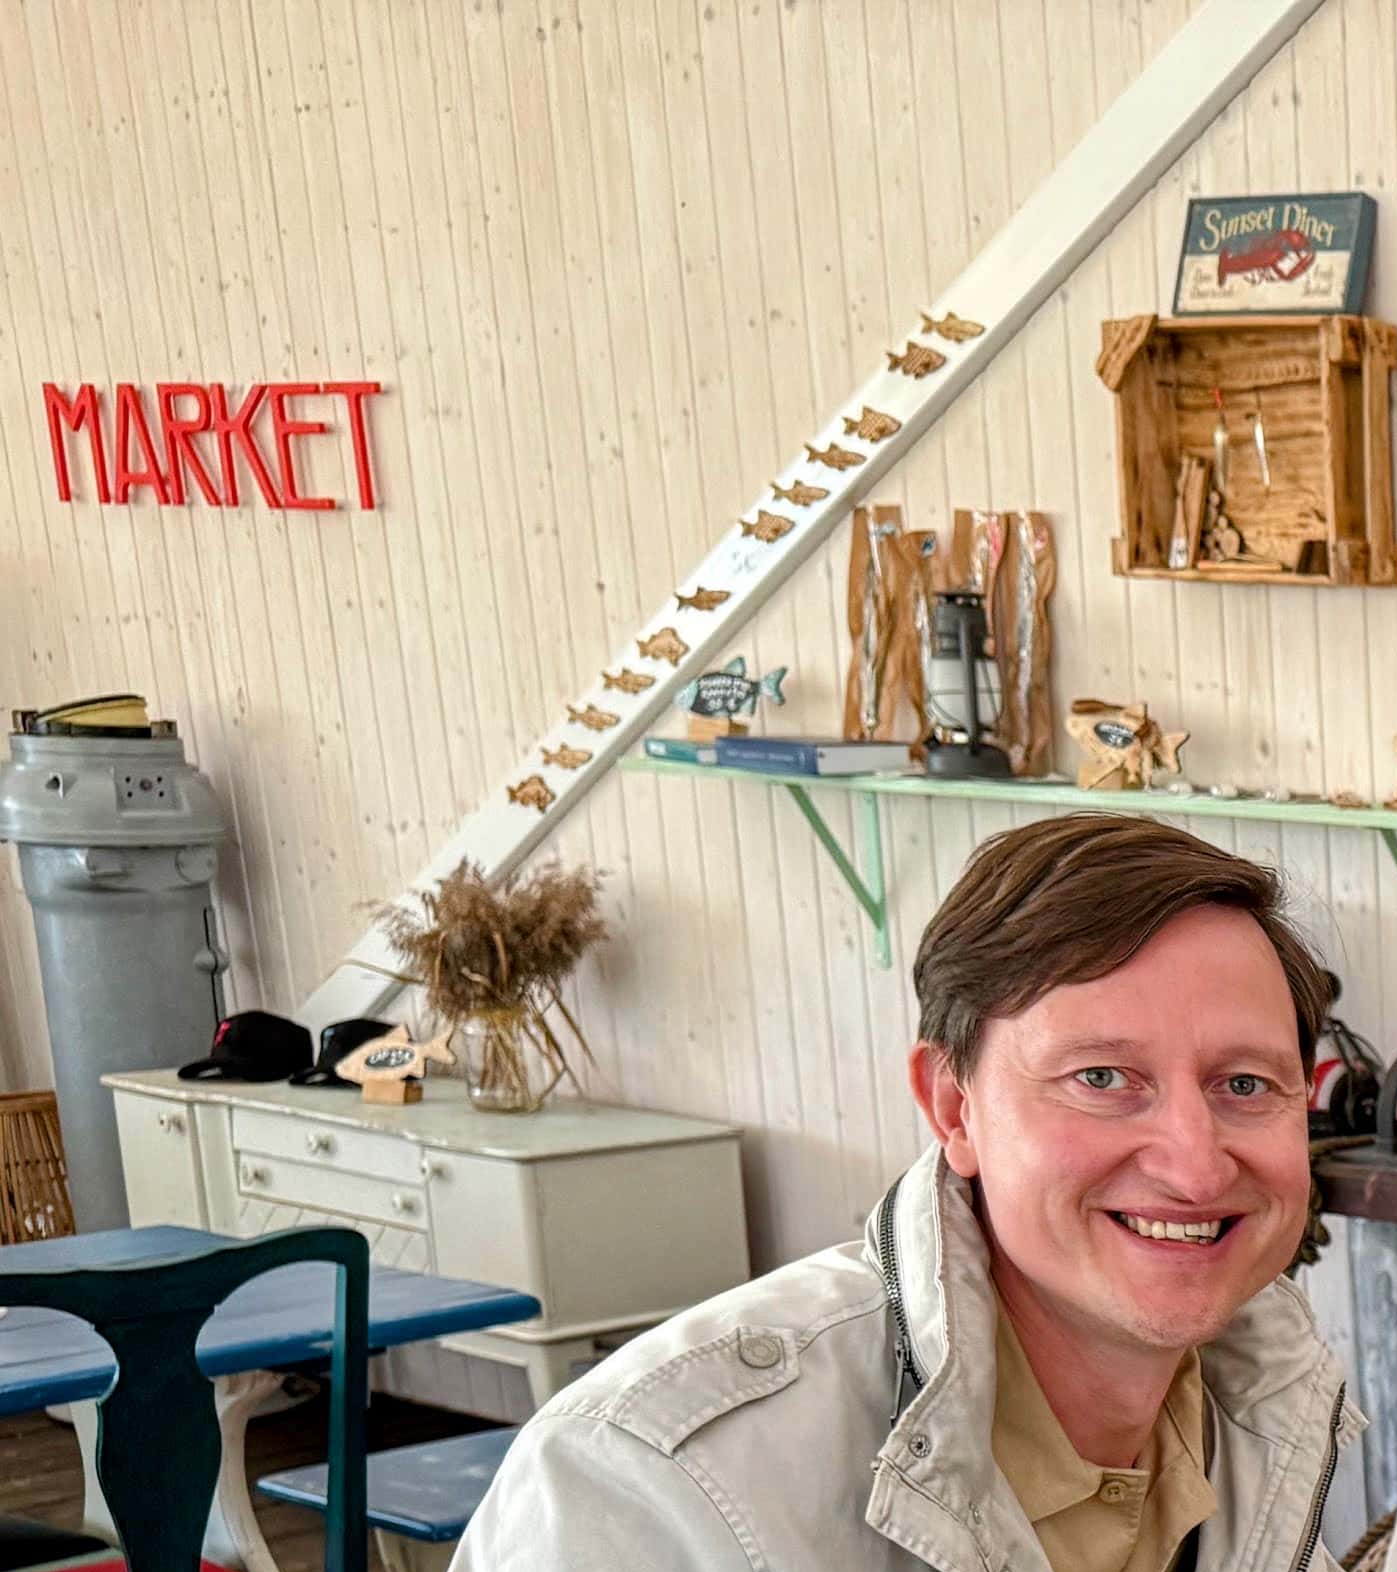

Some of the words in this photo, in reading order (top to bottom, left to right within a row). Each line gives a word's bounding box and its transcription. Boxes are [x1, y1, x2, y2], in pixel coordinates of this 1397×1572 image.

[1199, 207, 1275, 252] Sunset
[1282, 202, 1336, 248] Diner
[41, 381, 382, 511] MARKET
